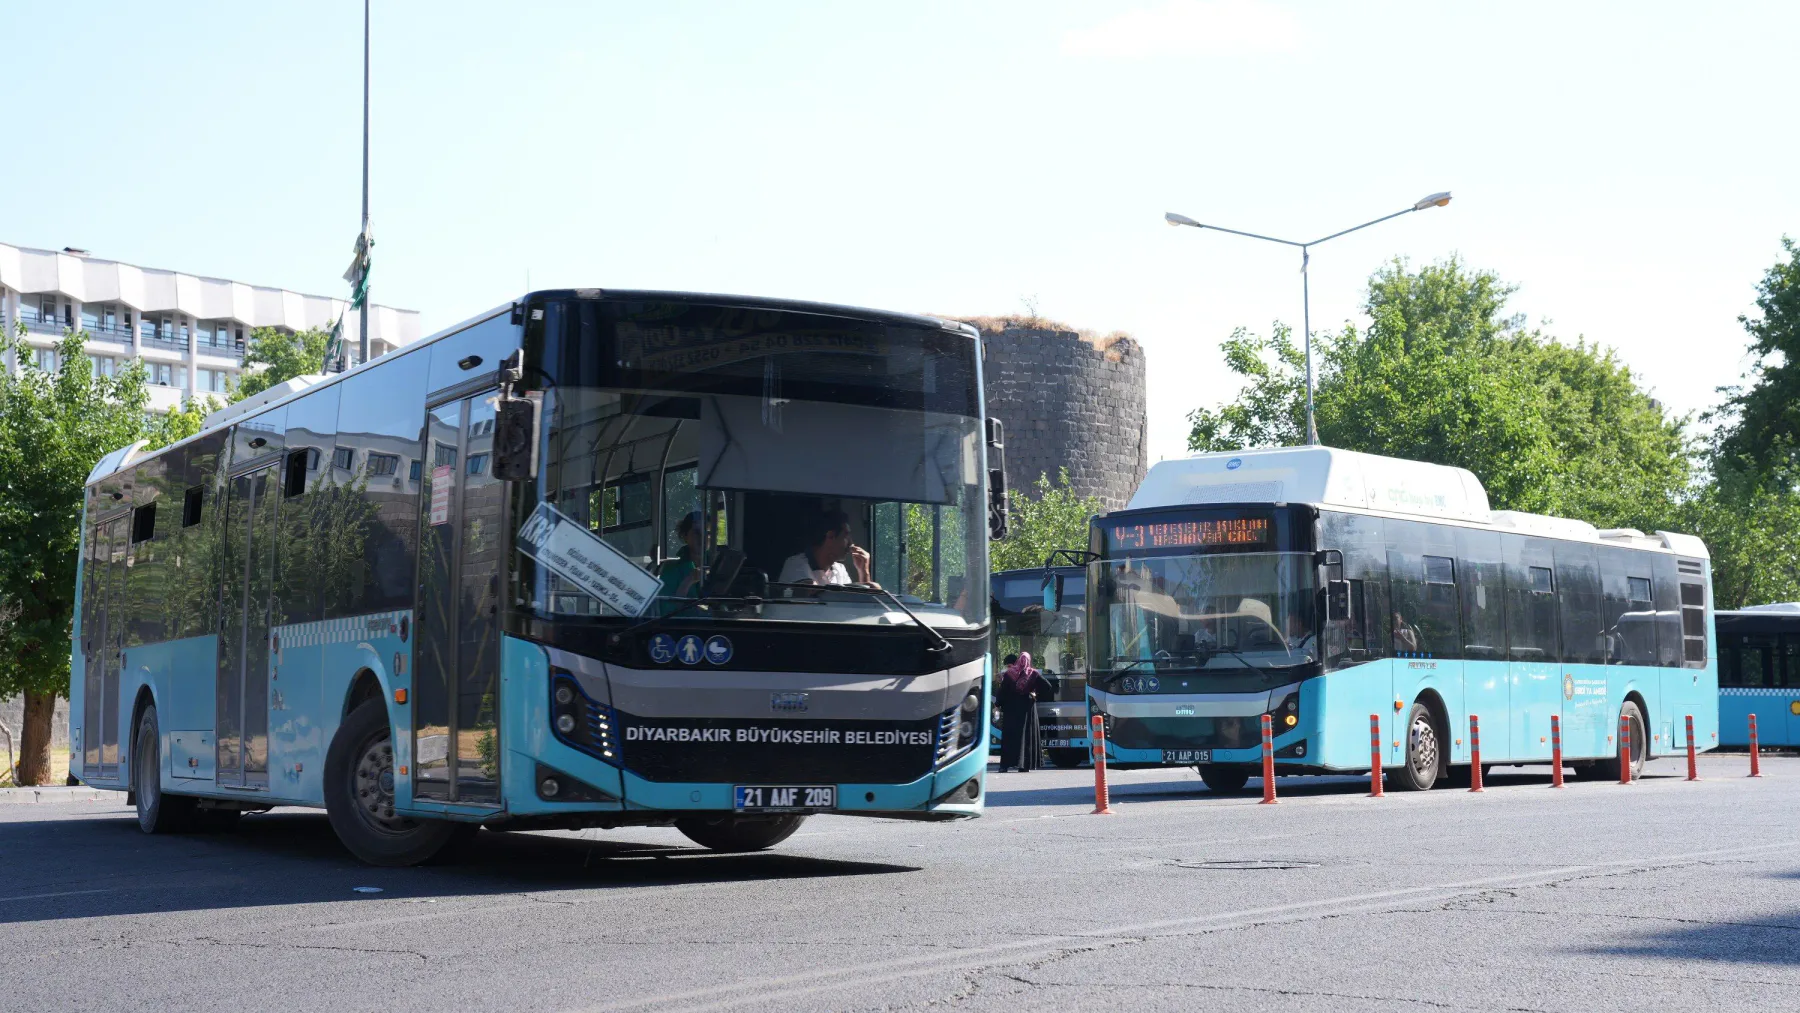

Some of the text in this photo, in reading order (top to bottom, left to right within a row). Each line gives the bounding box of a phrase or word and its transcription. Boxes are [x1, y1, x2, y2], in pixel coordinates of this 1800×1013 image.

[626, 725, 933, 745] DİYARBAKIR BÜYÜKŞEHİR BELEDİYESİ
[1167, 751, 1209, 761] 21 AAP 015
[744, 788, 762, 806] 21
[770, 788, 798, 806] AAF
[805, 788, 832, 806] 209
